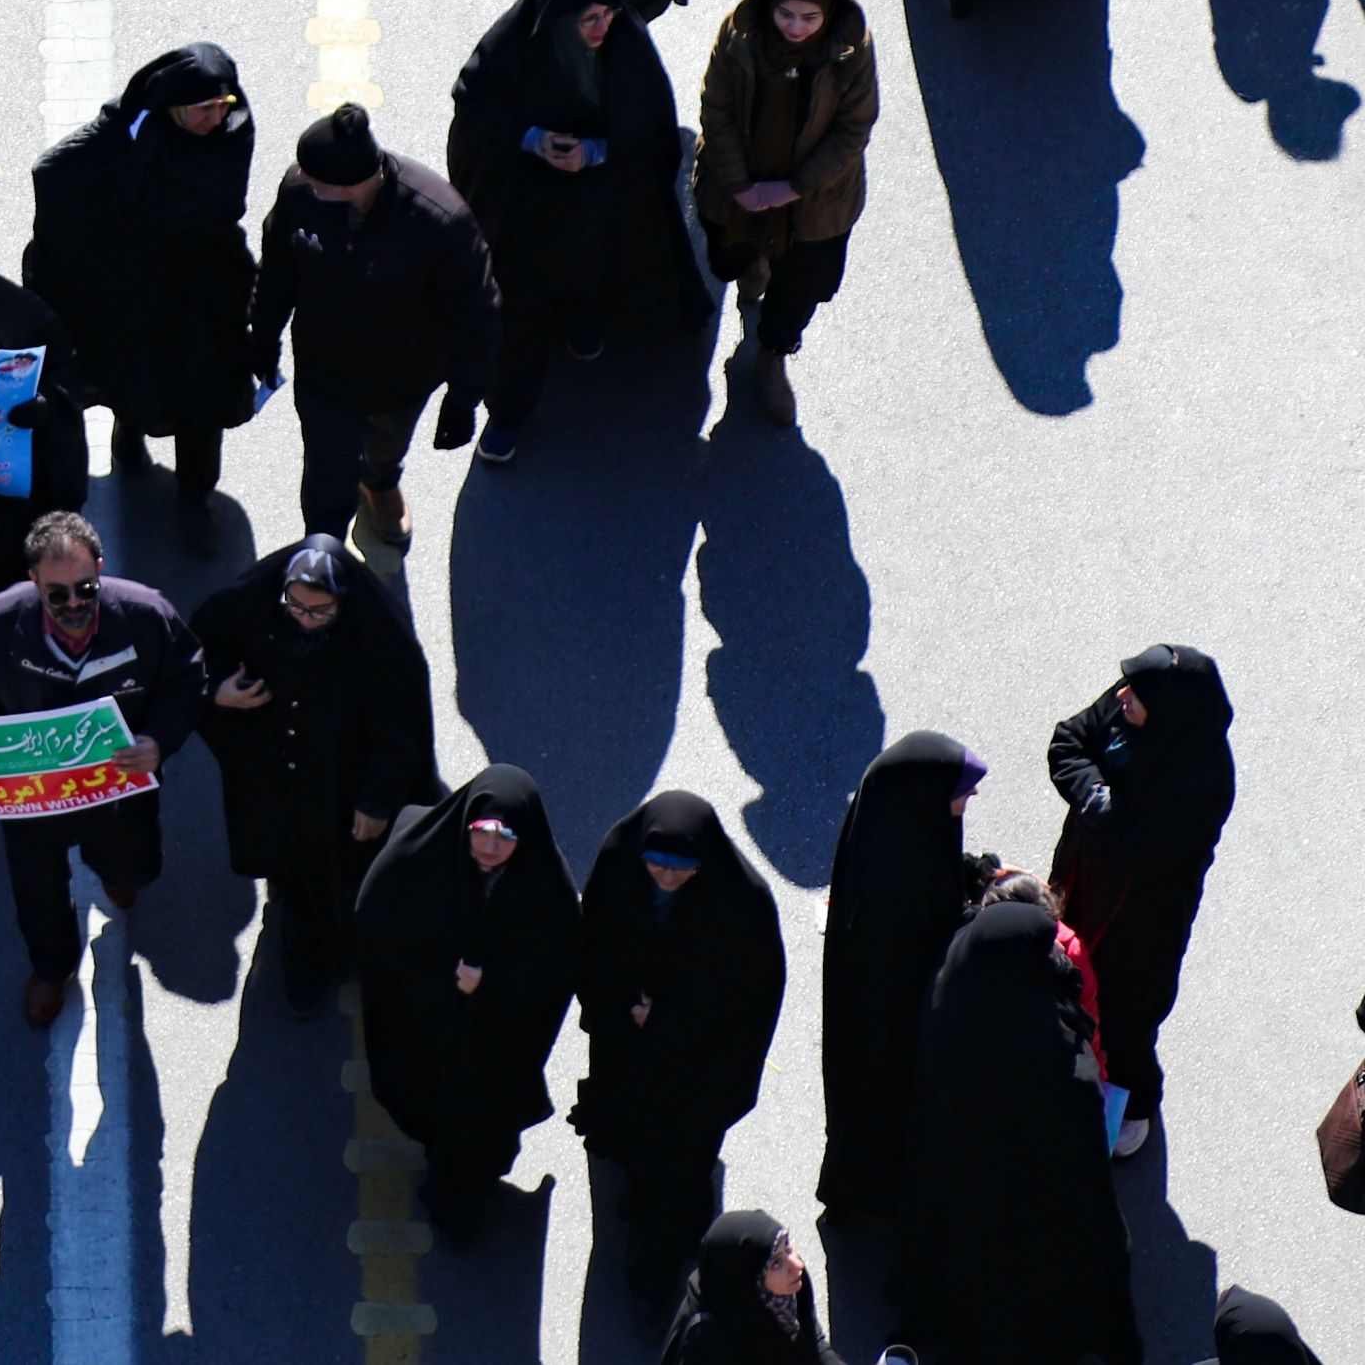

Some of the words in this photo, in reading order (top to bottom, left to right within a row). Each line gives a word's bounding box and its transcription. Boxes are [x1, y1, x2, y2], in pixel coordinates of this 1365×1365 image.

[45, 727, 73, 756] مردم
[60, 777, 80, 799] بر
[82, 765, 128, 787] رگ
[45, 794, 89, 810] WITH
[91, 780, 138, 799] U.S.A
